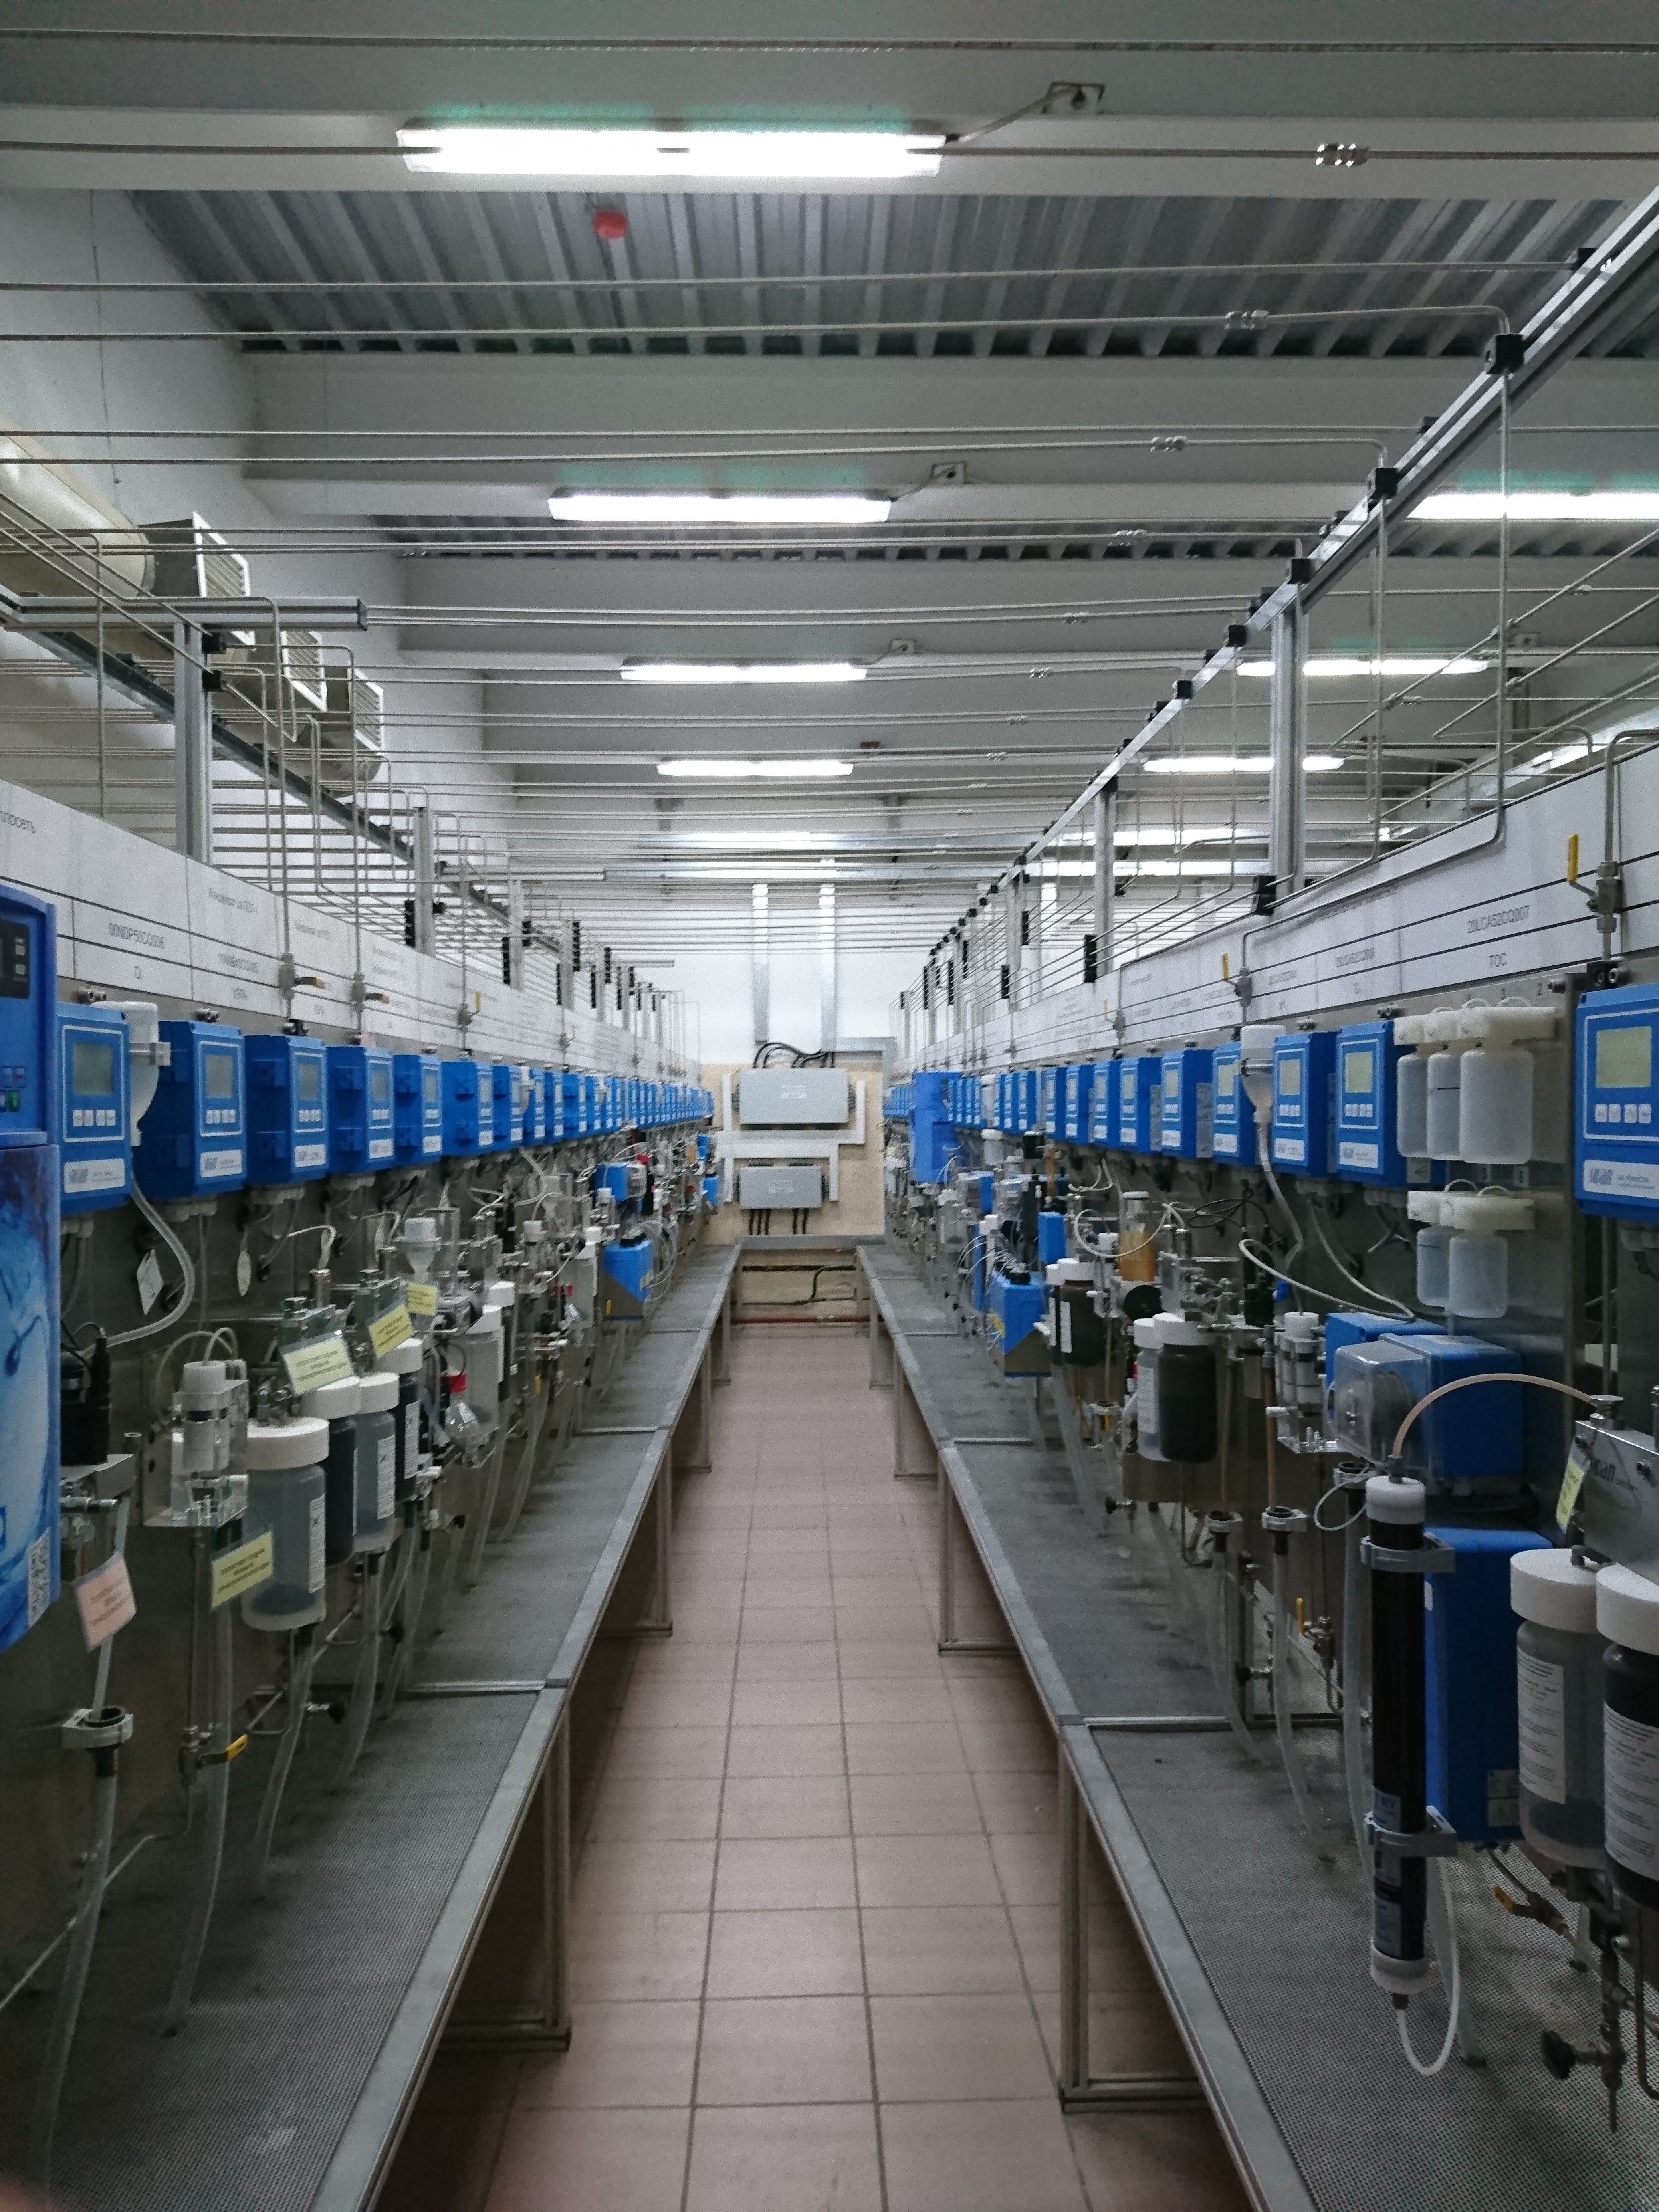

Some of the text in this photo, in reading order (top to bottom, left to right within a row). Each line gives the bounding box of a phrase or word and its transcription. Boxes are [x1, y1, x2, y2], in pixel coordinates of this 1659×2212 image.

[1467, 905, 1530, 934] 20LCA52CQ007
[1488, 953, 1508, 968] TOC
[1536, 982, 1543, 997] 2
